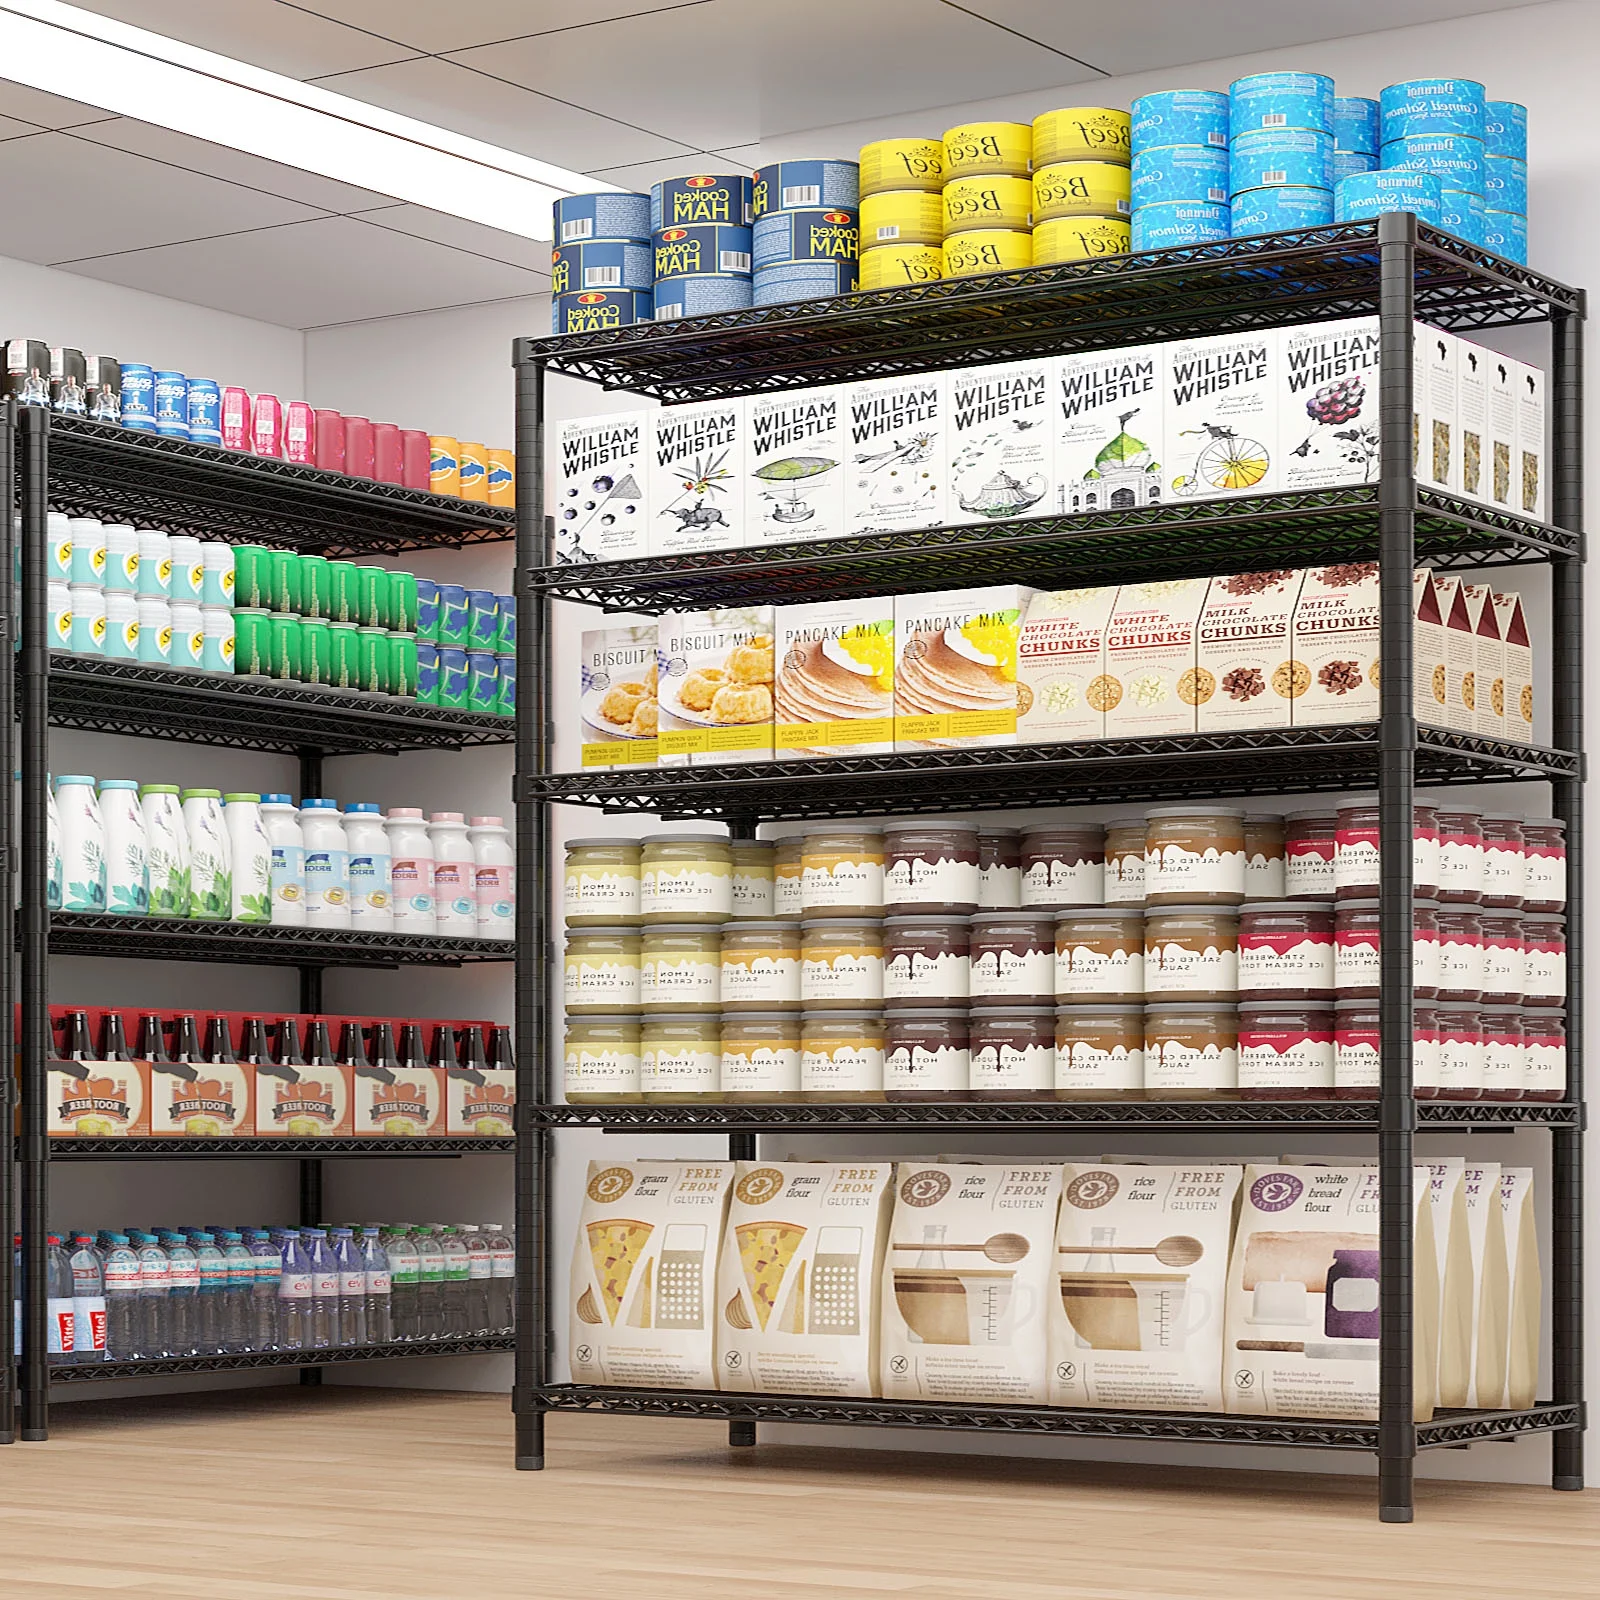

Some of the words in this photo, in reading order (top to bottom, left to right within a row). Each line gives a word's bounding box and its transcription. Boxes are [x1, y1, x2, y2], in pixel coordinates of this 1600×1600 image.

[1288, 335, 1380, 372] WILLIAM
[1172, 348, 1267, 385] WILLIAM
[1288, 350, 1380, 394] WHISTLE
[1061, 360, 1153, 398] WILLIAM
[1173, 364, 1267, 406] WHISTLE
[954, 376, 1045, 410] WILLIAM
[1061, 377, 1154, 420] WHISTLE
[851, 390, 937, 424] WILLIAM
[954, 390, 1045, 432] WHISTLE
[754, 402, 836, 436] WILLIAM
[852, 405, 938, 444] WHISTLE
[656, 414, 736, 447] WILLIAM
[754, 416, 836, 456] WHISTLE
[562, 426, 638, 459] WILLIAM
[656, 429, 736, 467] WHISTLE
[563, 442, 639, 478] WHISTLE
[1300, 600, 1346, 610] MILK
[1205, 608, 1250, 618] MILK
[1297, 606, 1379, 619] CHOCOLAT
[905, 614, 970, 634] PANCAKE
[978, 612, 1005, 628] MIX
[1112, 614, 1170, 626] WHITE
[1202, 614, 1288, 627] CHOCOLATE
[1296, 615, 1380, 631] CHUNKS
[786, 625, 848, 644] PANCAKE
[856, 623, 881, 638] MIX
[1024, 622, 1080, 633] WHITE
[1110, 622, 1193, 634] CHOCOLATE
[1200, 622, 1286, 639] CHUNKS
[670, 634, 725, 652] BISCUIT
[733, 632, 757, 646] MIX
[1020, 629, 1102, 642] CHOCOLATE
[1108, 630, 1192, 646] CHUNKS
[1019, 638, 1100, 654] CHUNKS
[593, 650, 646, 666] BISCUIT
[640, 1175, 668, 1185] gram
[685, 1168, 722, 1179] FREE
[838, 1170, 878, 1180] FREE
[1010, 1171, 1052, 1182] FREE
[1180, 1172, 1225, 1183] FREE
[1315, 1174, 1349, 1185] white
[678, 1182, 718, 1192] FROM
[792, 1176, 820, 1186] gram
[964, 1176, 986, 1185] rice
[1134, 1176, 1156, 1186] rice
[634, 1186, 658, 1196] flour
[786, 1188, 811, 1198] flour
[832, 1184, 873, 1193] FROM
[958, 1189, 986, 1199] flour
[1002, 1186, 1048, 1196] FROM
[1128, 1190, 1156, 1200] flour
[1174, 1187, 1222, 1197] FROM
[1308, 1188, 1342, 1199] bread
[674, 1196, 714, 1204] GLUTEN
[827, 1198, 870, 1206] GLUTEN
[999, 1200, 1044, 1209] GLUTEN
[1170, 1202, 1217, 1210] GLUTEN
[1304, 1203, 1331, 1214] flour
[64, 1315, 74, 1348] Vittel
[95, 1314, 106, 1347] Vittel
